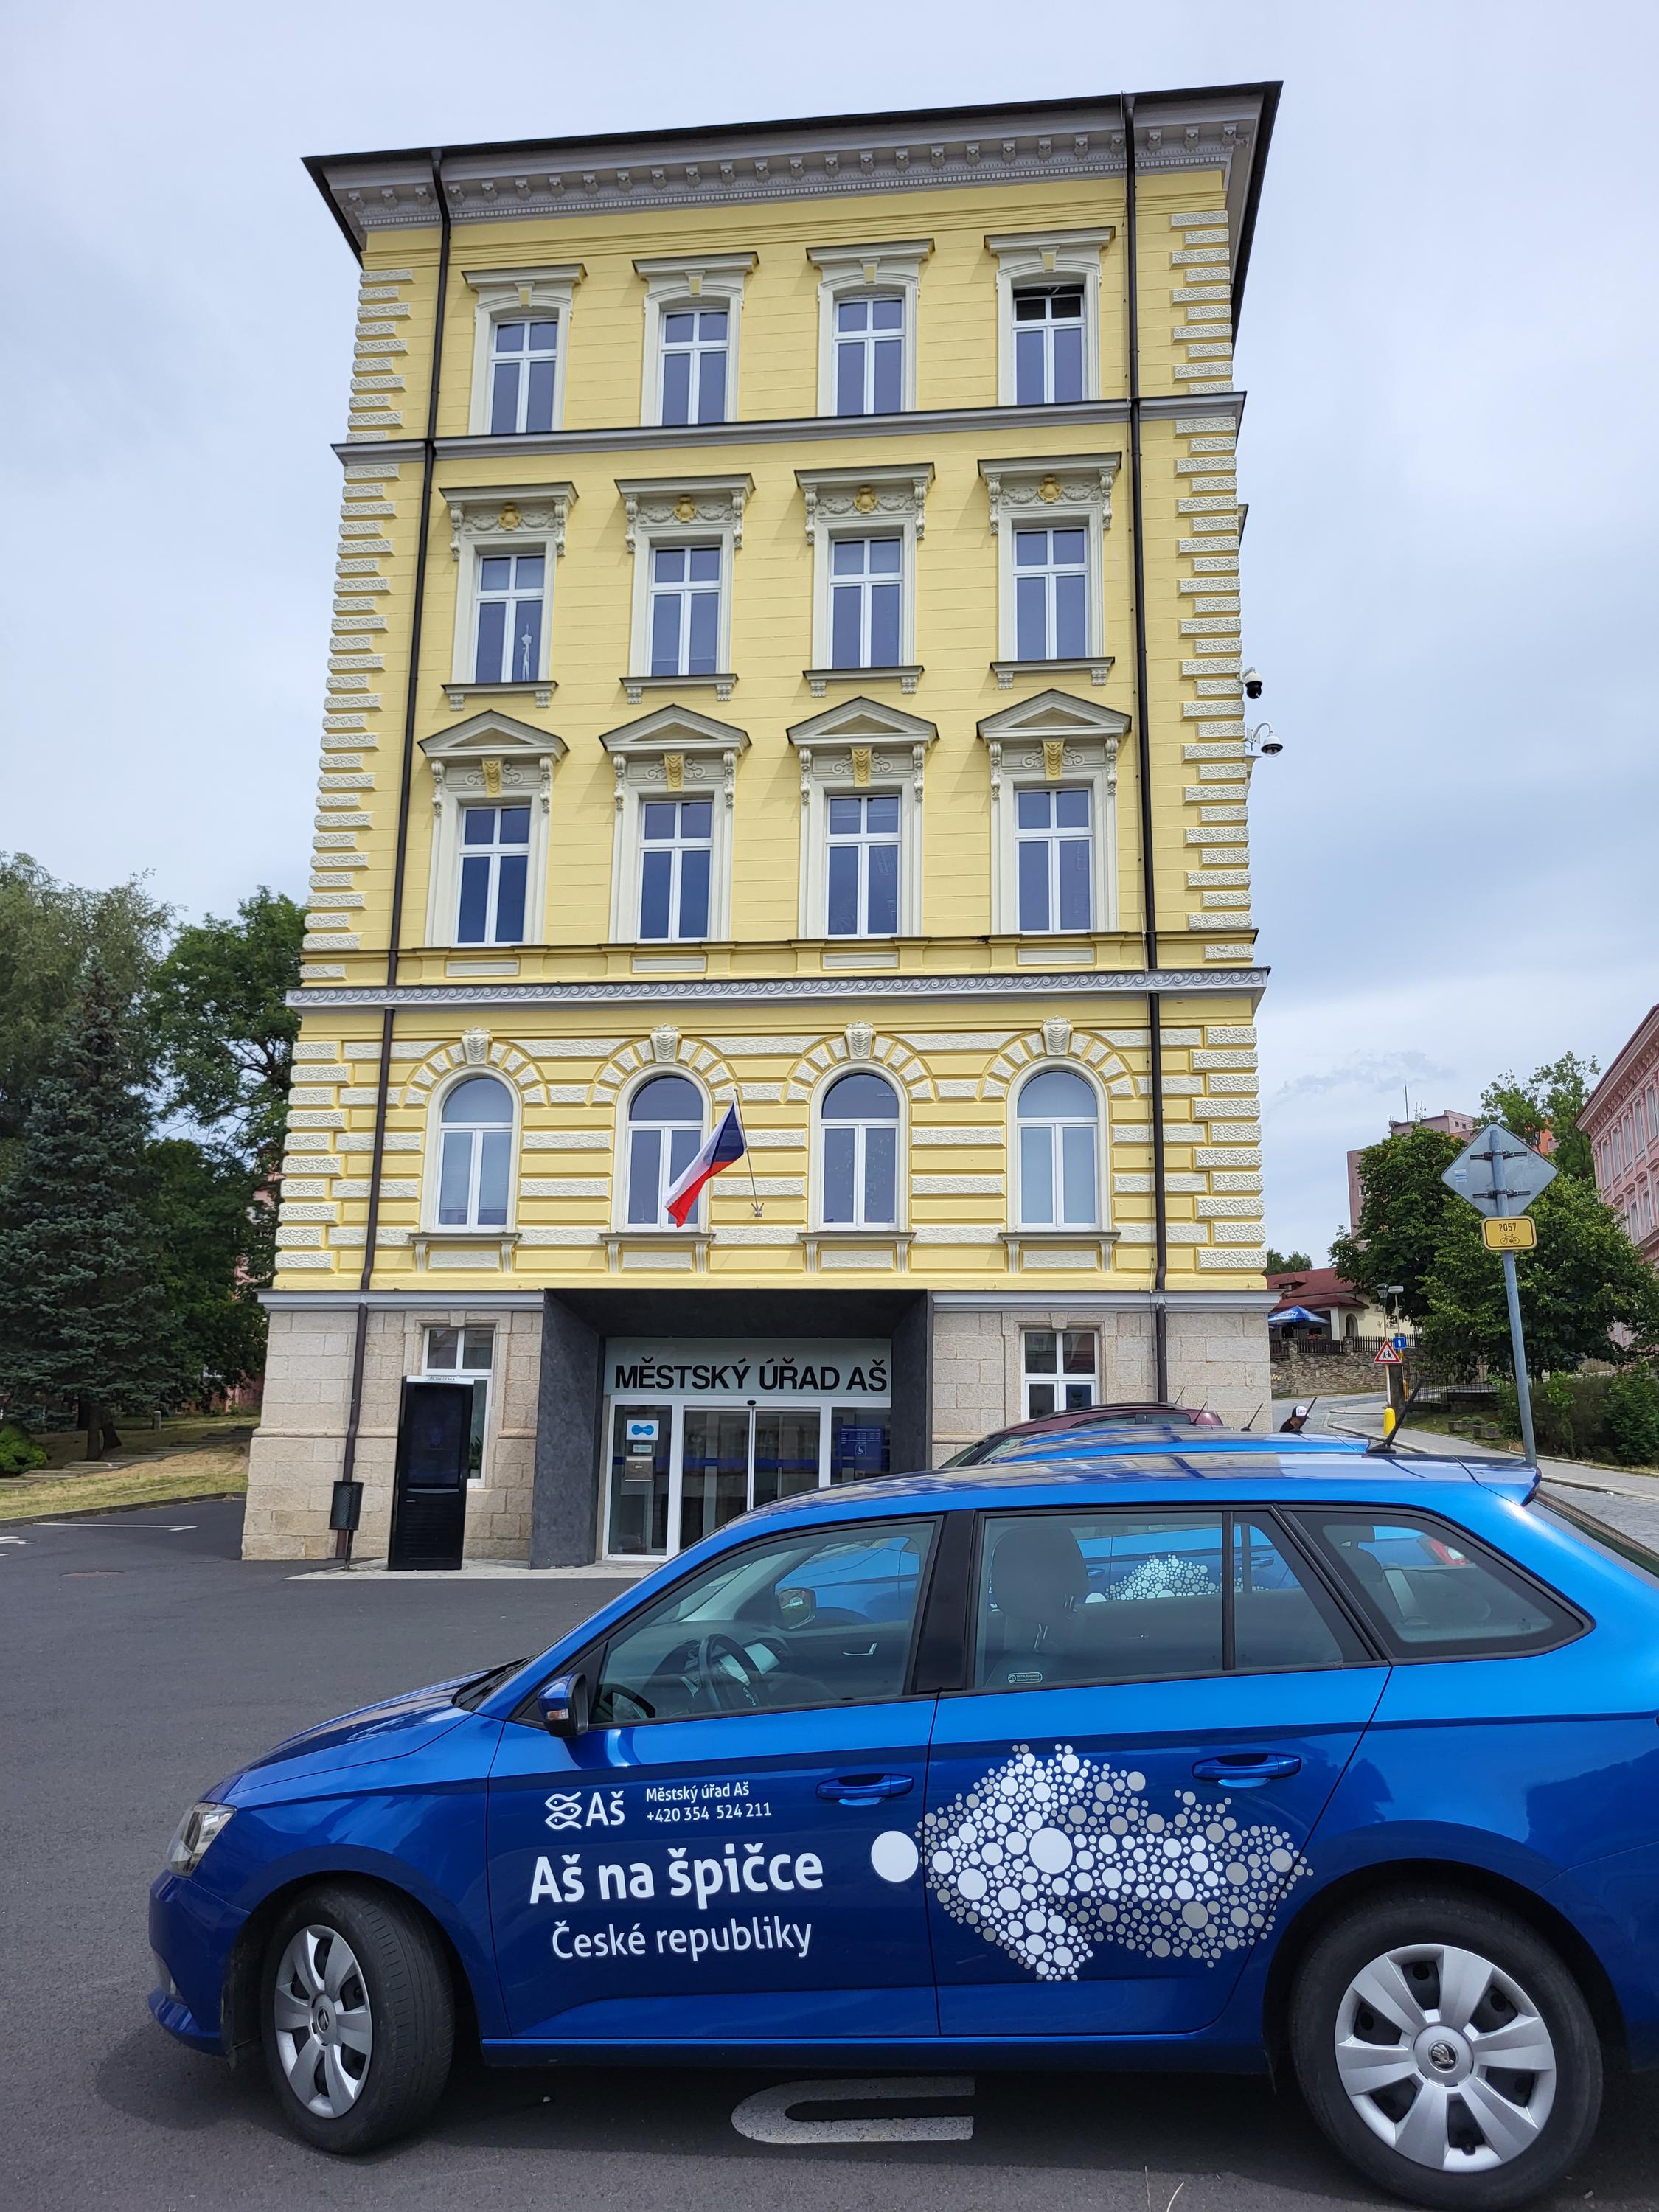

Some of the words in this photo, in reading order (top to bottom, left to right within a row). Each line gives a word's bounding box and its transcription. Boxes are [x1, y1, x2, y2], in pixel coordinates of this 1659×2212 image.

[1498, 1222, 1517, 1232] 2057
[615, 1357, 751, 1389] MĚSTSKÝ
[759, 1357, 841, 1391] ÚŘAD
[846, 1359, 887, 1392] AŠ
[586, 1790, 625, 1827] Aš
[646, 1784, 698, 1804] Městský
[702, 1783, 731, 1799] úřad
[734, 1781, 750, 1797] Aš
[647, 1808, 681, 1823] +420
[684, 1806, 710, 1821] 354
[717, 1804, 742, 1819] 524
[746, 1802, 772, 1818] 211
[529, 1854, 585, 1904] Aš
[598, 1863, 655, 1900] na
[667, 1843, 824, 1910] špičce
[552, 1919, 646, 1958] České
[656, 1915, 812, 1962] republiky
